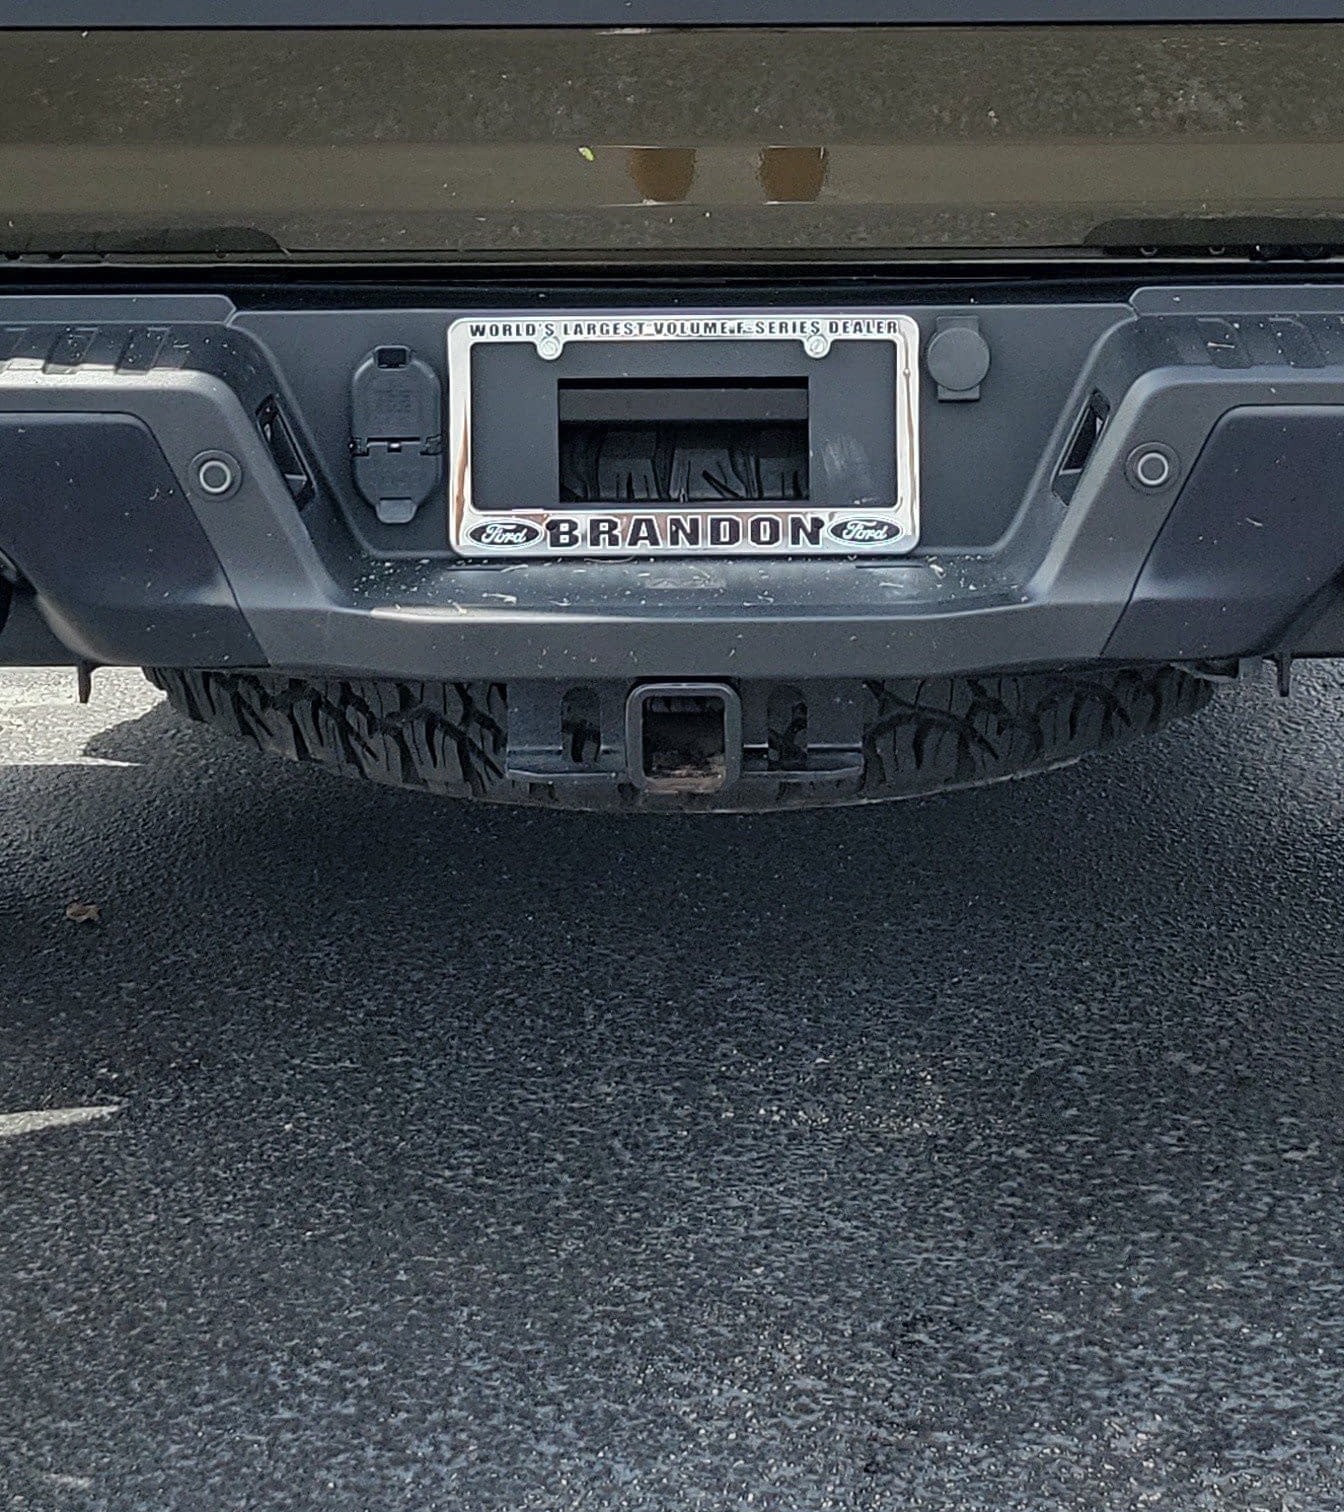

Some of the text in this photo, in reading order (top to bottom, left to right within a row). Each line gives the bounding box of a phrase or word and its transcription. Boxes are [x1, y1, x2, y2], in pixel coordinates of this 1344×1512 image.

[470, 322, 555, 337] WORLD'S
[563, 321, 645, 336] LARGEST
[653, 321, 728, 335] VOLUME
[828, 320, 898, 334] DEALER
[481, 516, 887, 548] Ford BRANDON Ford
